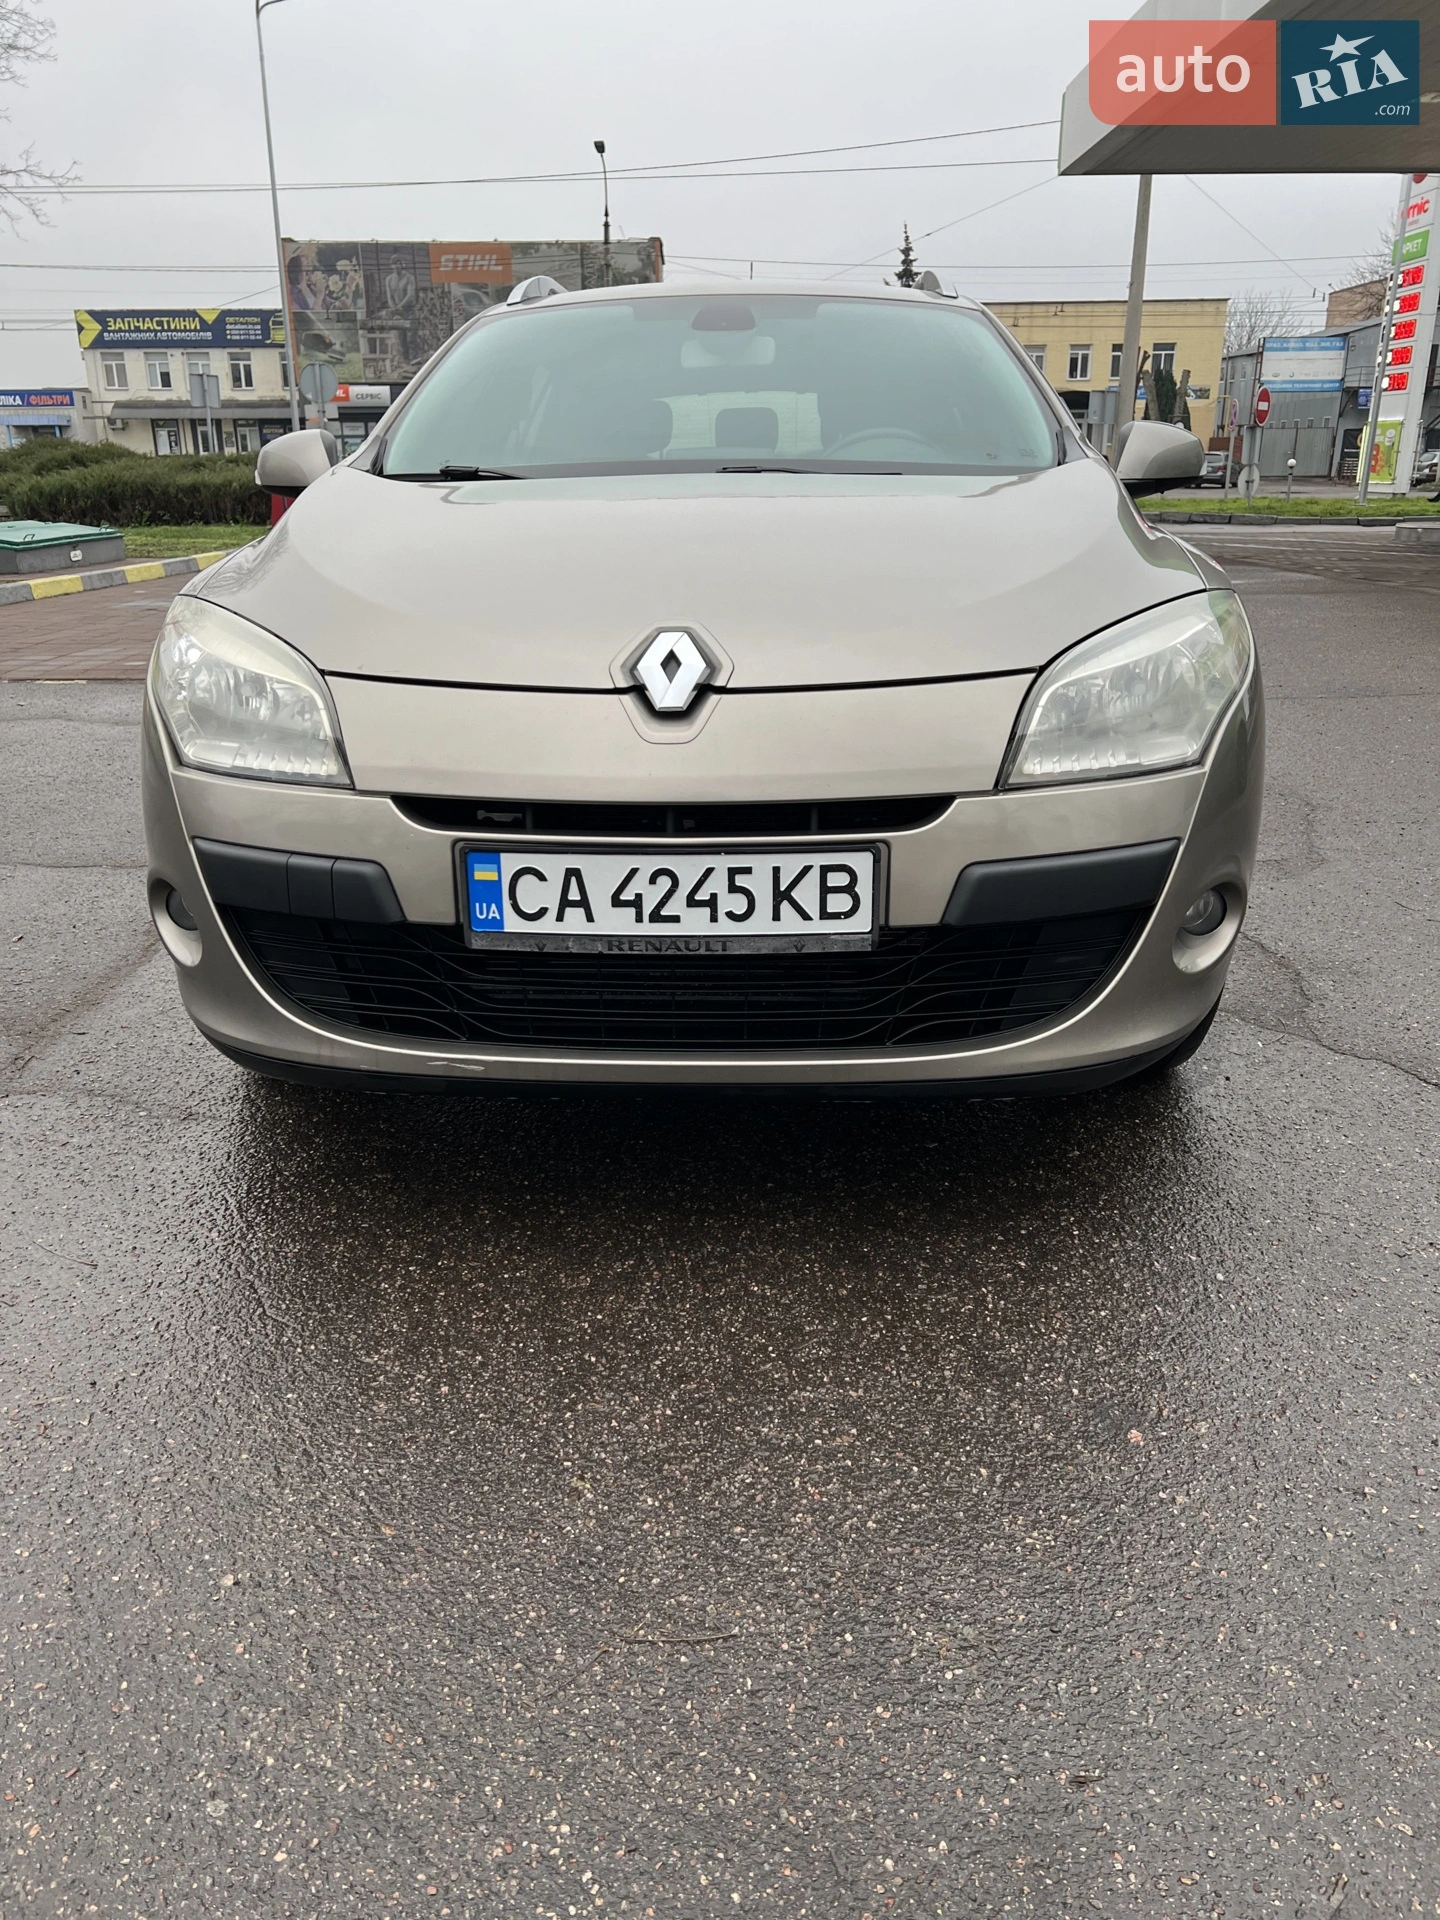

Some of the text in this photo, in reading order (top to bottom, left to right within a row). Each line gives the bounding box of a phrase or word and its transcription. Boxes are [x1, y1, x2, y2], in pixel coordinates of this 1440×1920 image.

[1402, 238, 1423, 255] АРКЕТ
[439, 254, 503, 271] STIHL
[106, 317, 200, 331] ЗАПЧАСТИНИ
[103, 331, 212, 340] ВАНТАЖНИХ АВТОМОБІЛІВ
[29, 394, 70, 405] ФІЛЬТРИ
[508, 863, 861, 924] CA 4245 KB
[475, 902, 500, 920] UA
[607, 939, 733, 953] RENAULT
